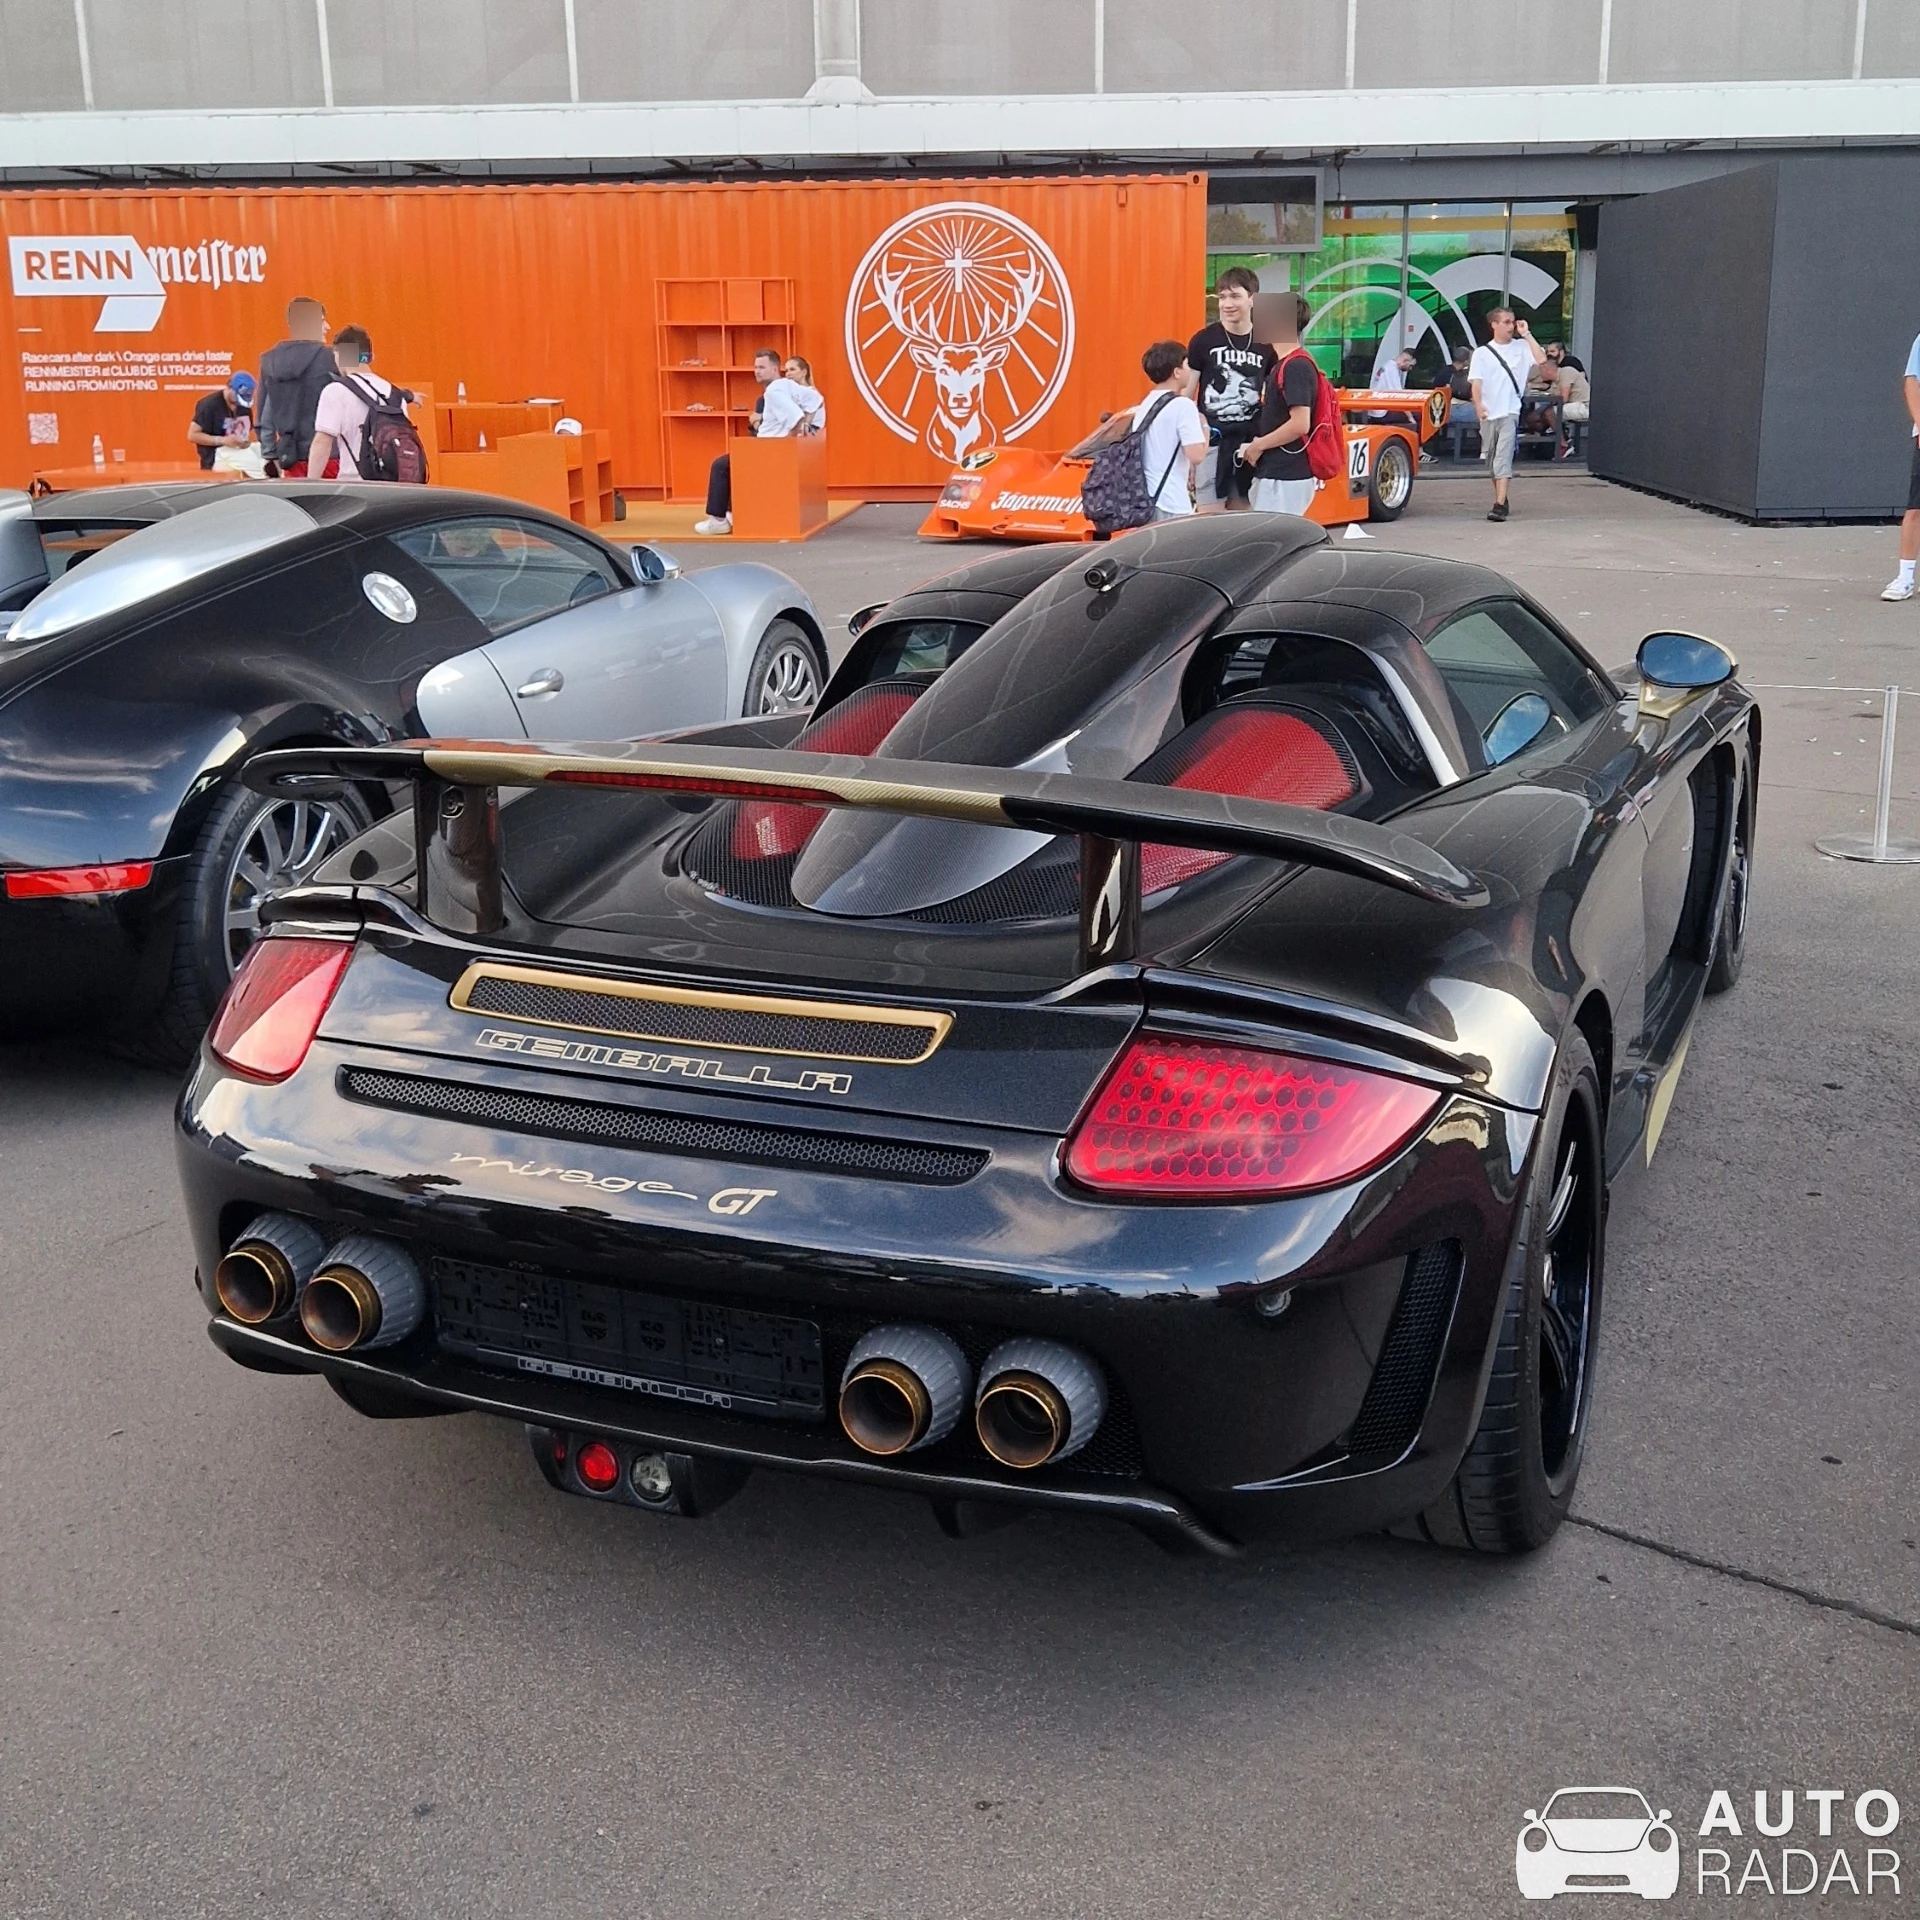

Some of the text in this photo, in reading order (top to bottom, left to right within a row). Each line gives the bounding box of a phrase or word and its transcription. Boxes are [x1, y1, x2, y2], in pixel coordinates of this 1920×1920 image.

[94, 351, 115, 362] dark
[123, 351, 160, 364] Orange
[181, 351, 205, 362] drive
[205, 351, 233, 362] faster
[1209, 346, 1264, 368] Tupac
[24, 365, 101, 377] RENNMEISTER
[205, 364, 231, 376] 2025
[25, 380, 75, 392] RUNNING
[1351, 442, 1368, 476] 16
[939, 499, 971, 510] SACHS
[475, 1028, 853, 1095] GEMBALLA
[449, 1151, 777, 1216] mirage GT
[517, 1356, 732, 1409] GEMBALLA
